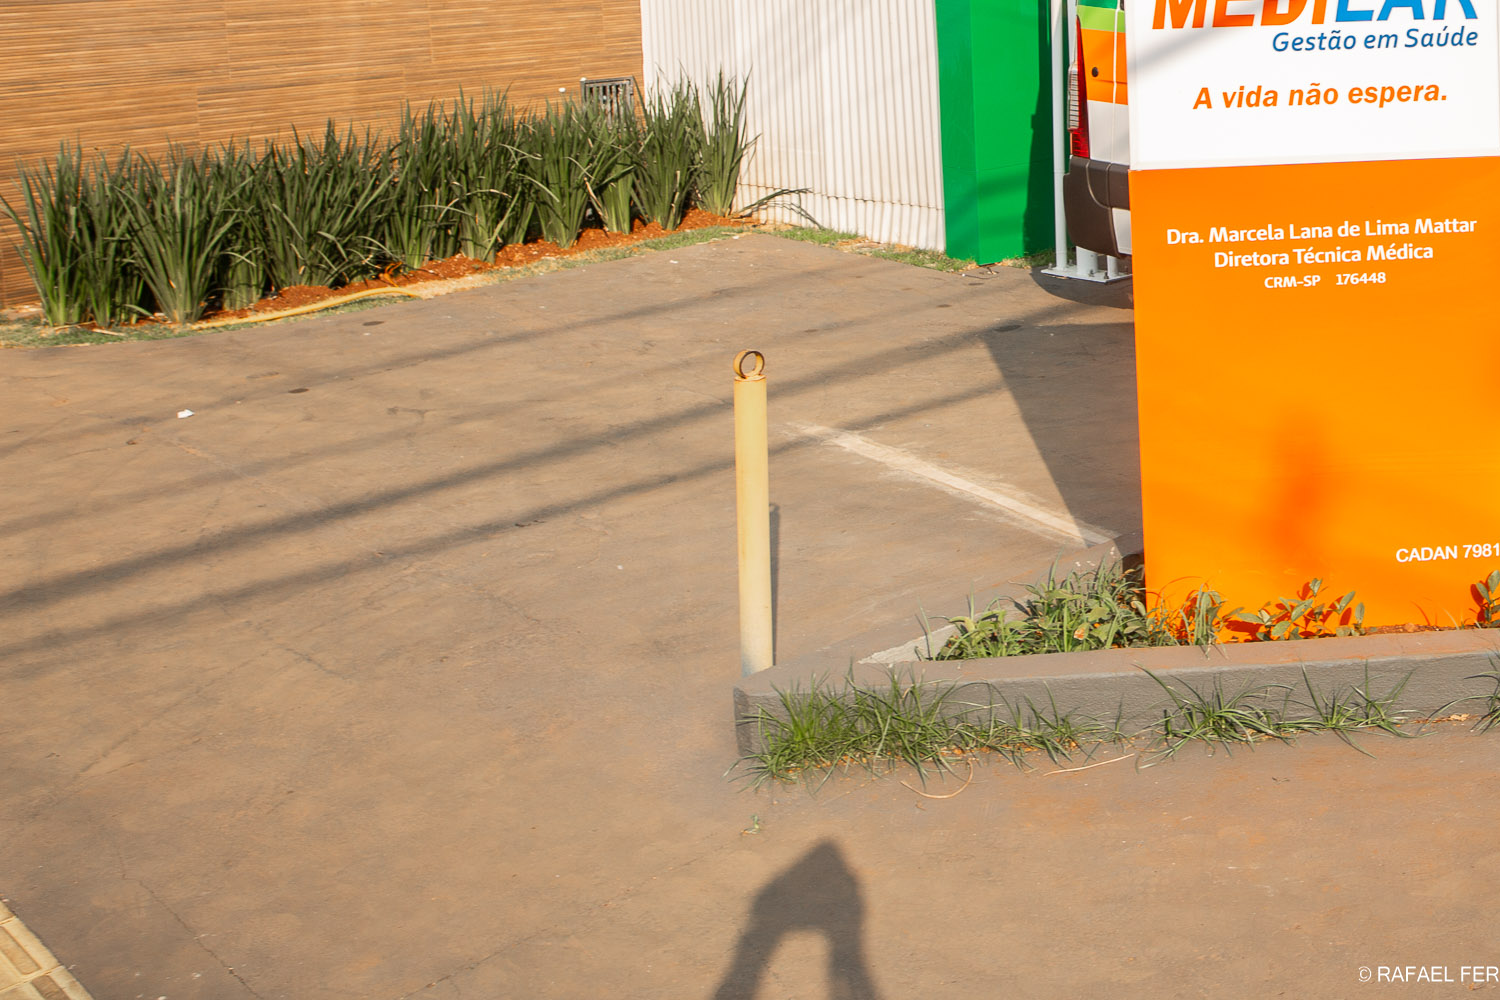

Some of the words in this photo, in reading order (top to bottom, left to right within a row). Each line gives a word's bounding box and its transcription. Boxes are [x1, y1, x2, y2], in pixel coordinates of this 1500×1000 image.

[1272, 29, 1357, 52] Gestão
[1363, 34, 1399, 50] em
[1404, 26, 1479, 48] Saúde
[1193, 87, 1213, 110] A
[1222, 85, 1279, 109] vida
[1288, 83, 1339, 106] não
[1347, 84, 1448, 109] espera.
[1166, 228, 1204, 245] Dra.
[1208, 224, 1284, 243] Marcela
[1289, 223, 1333, 240] Lana
[1338, 221, 1361, 238] de
[1365, 219, 1410, 236] Lima
[1414, 218, 1478, 236] Mattar
[1214, 250, 1290, 268] Diretora
[1293, 246, 1362, 265] Técnica
[1366, 243, 1434, 262] Médica
[1264, 274, 1321, 289] CRM-SP
[1335, 272, 1387, 286] 176448
[1396, 546, 1458, 563] CADAN
[1463, 543, 1500, 559] 7981
